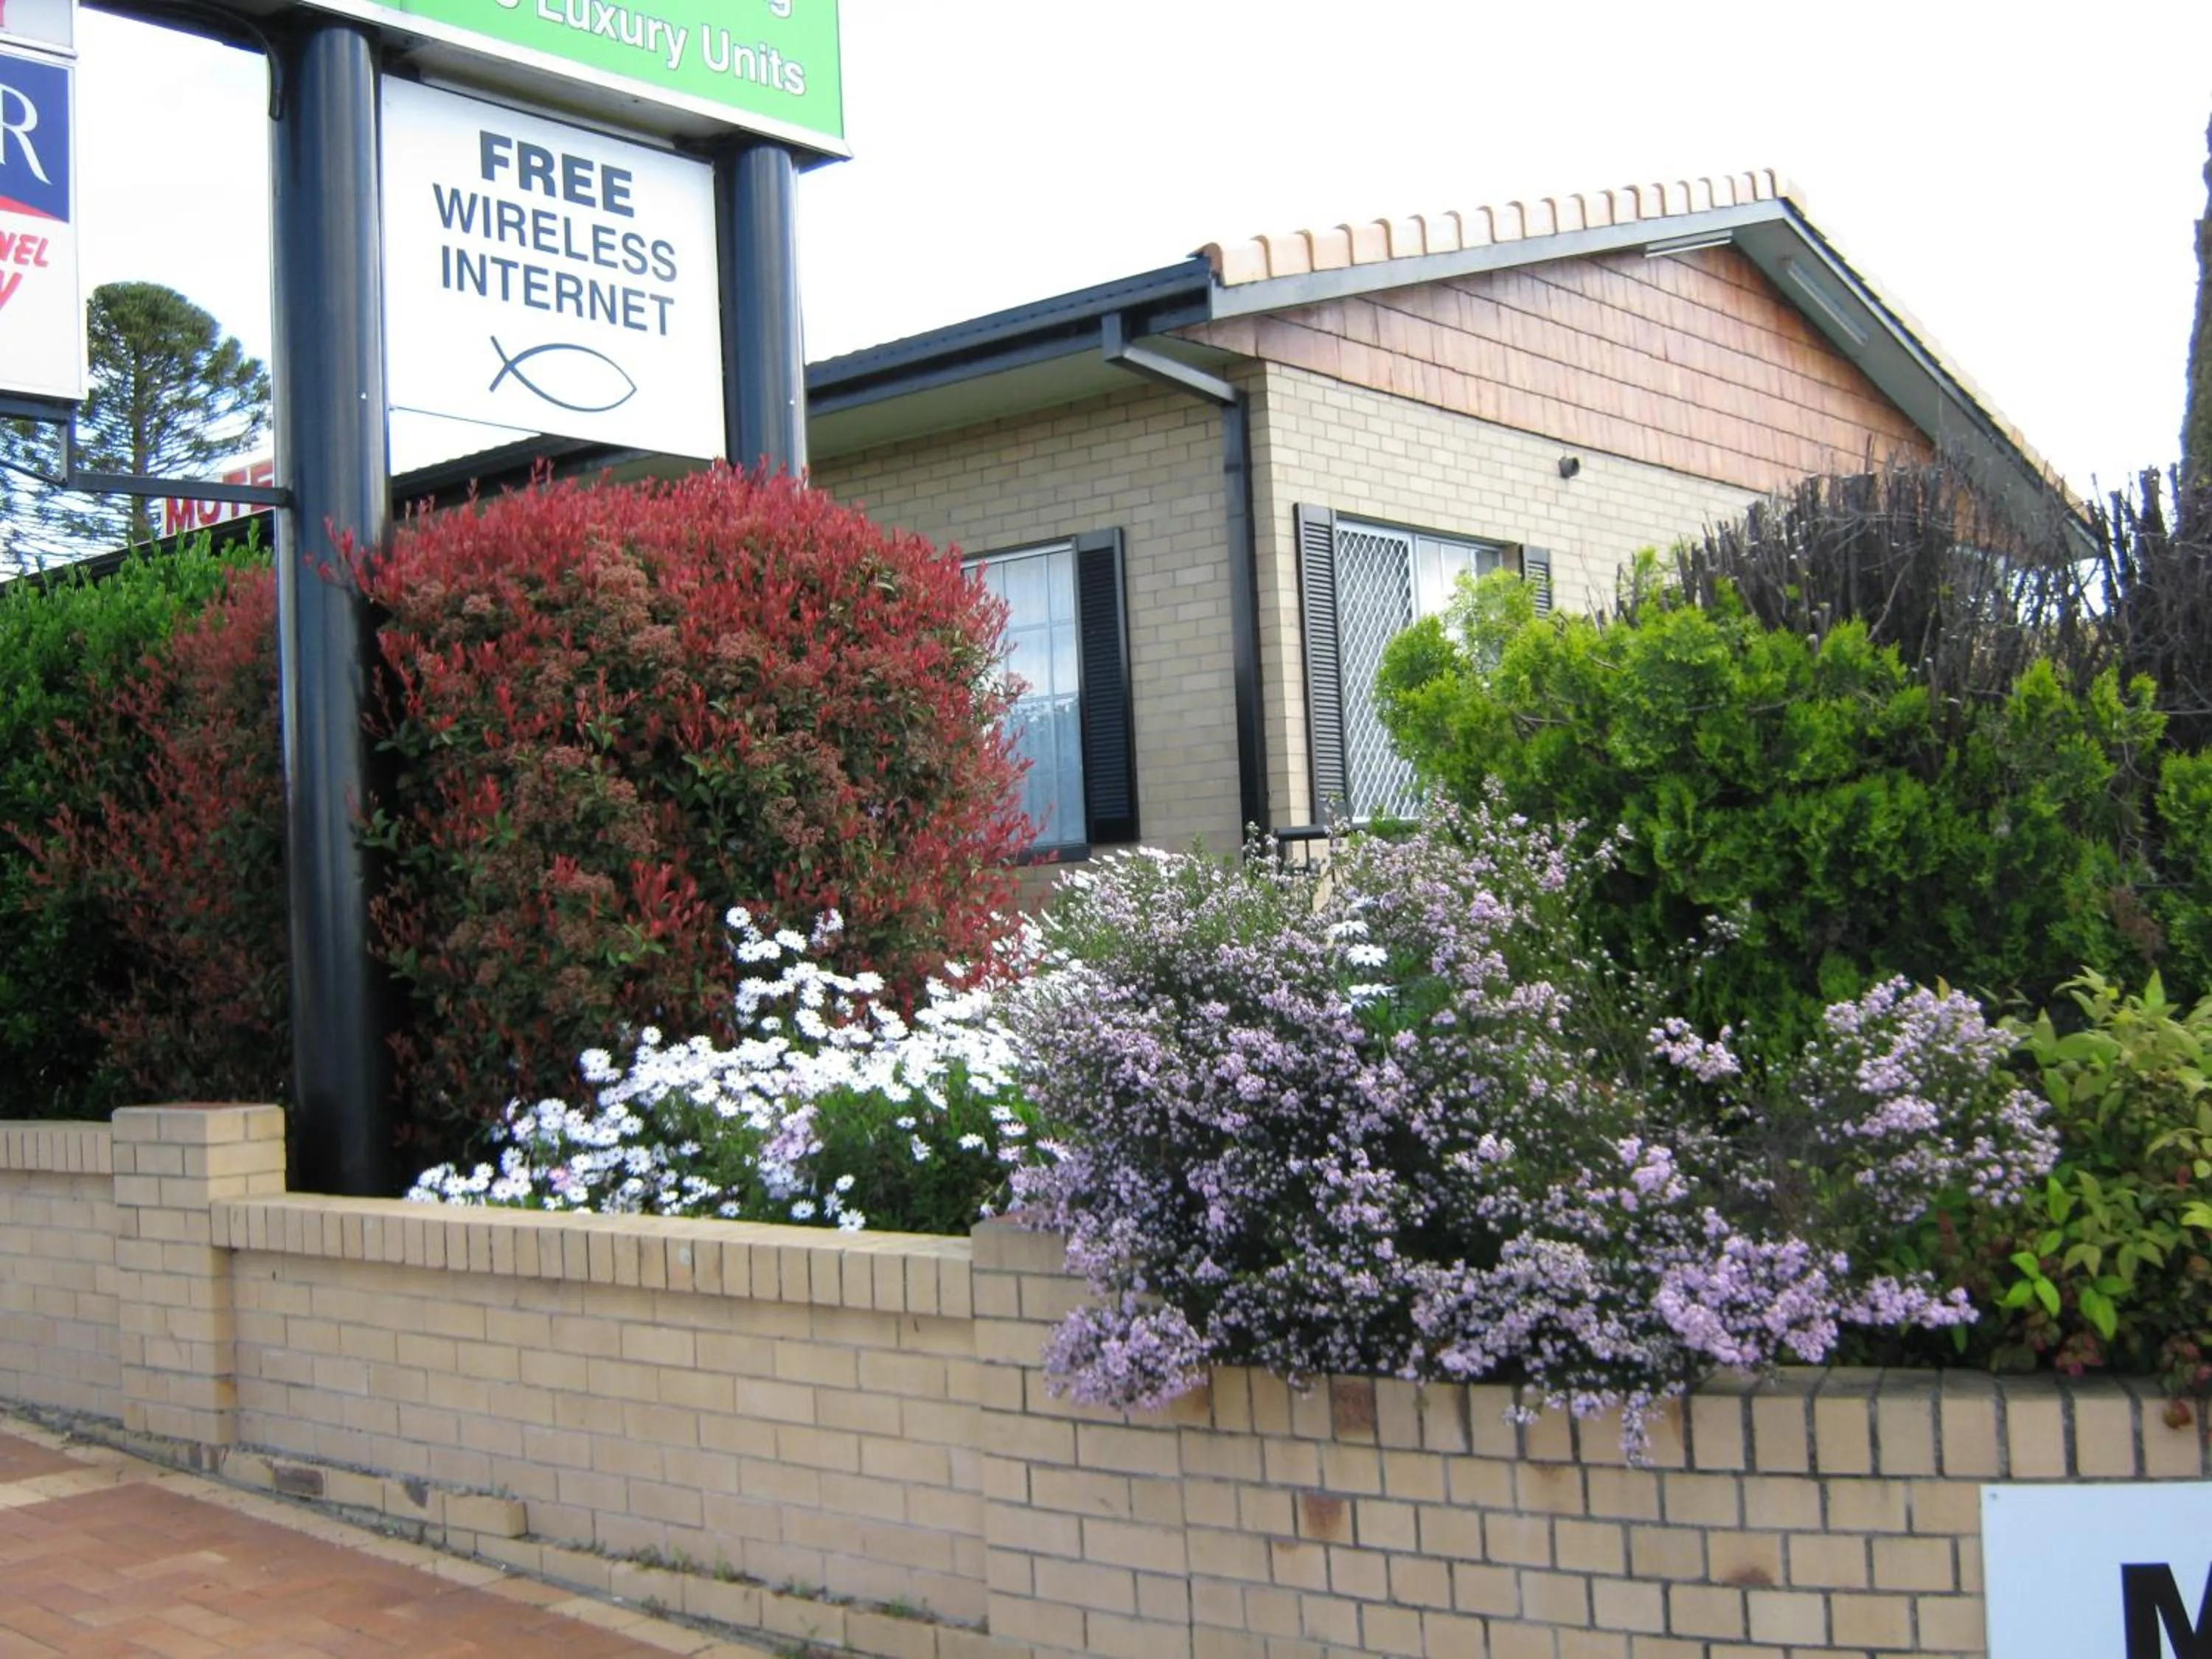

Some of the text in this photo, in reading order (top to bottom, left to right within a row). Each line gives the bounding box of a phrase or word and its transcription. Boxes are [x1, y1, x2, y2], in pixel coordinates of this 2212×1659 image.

[537, 0, 807, 97] Luxury Units
[479, 130, 635, 218] FREE
[432, 182, 678, 282] WIRELESS
[442, 245, 675, 335] INTERNET
[2121, 1562, 2212, 1659] M
